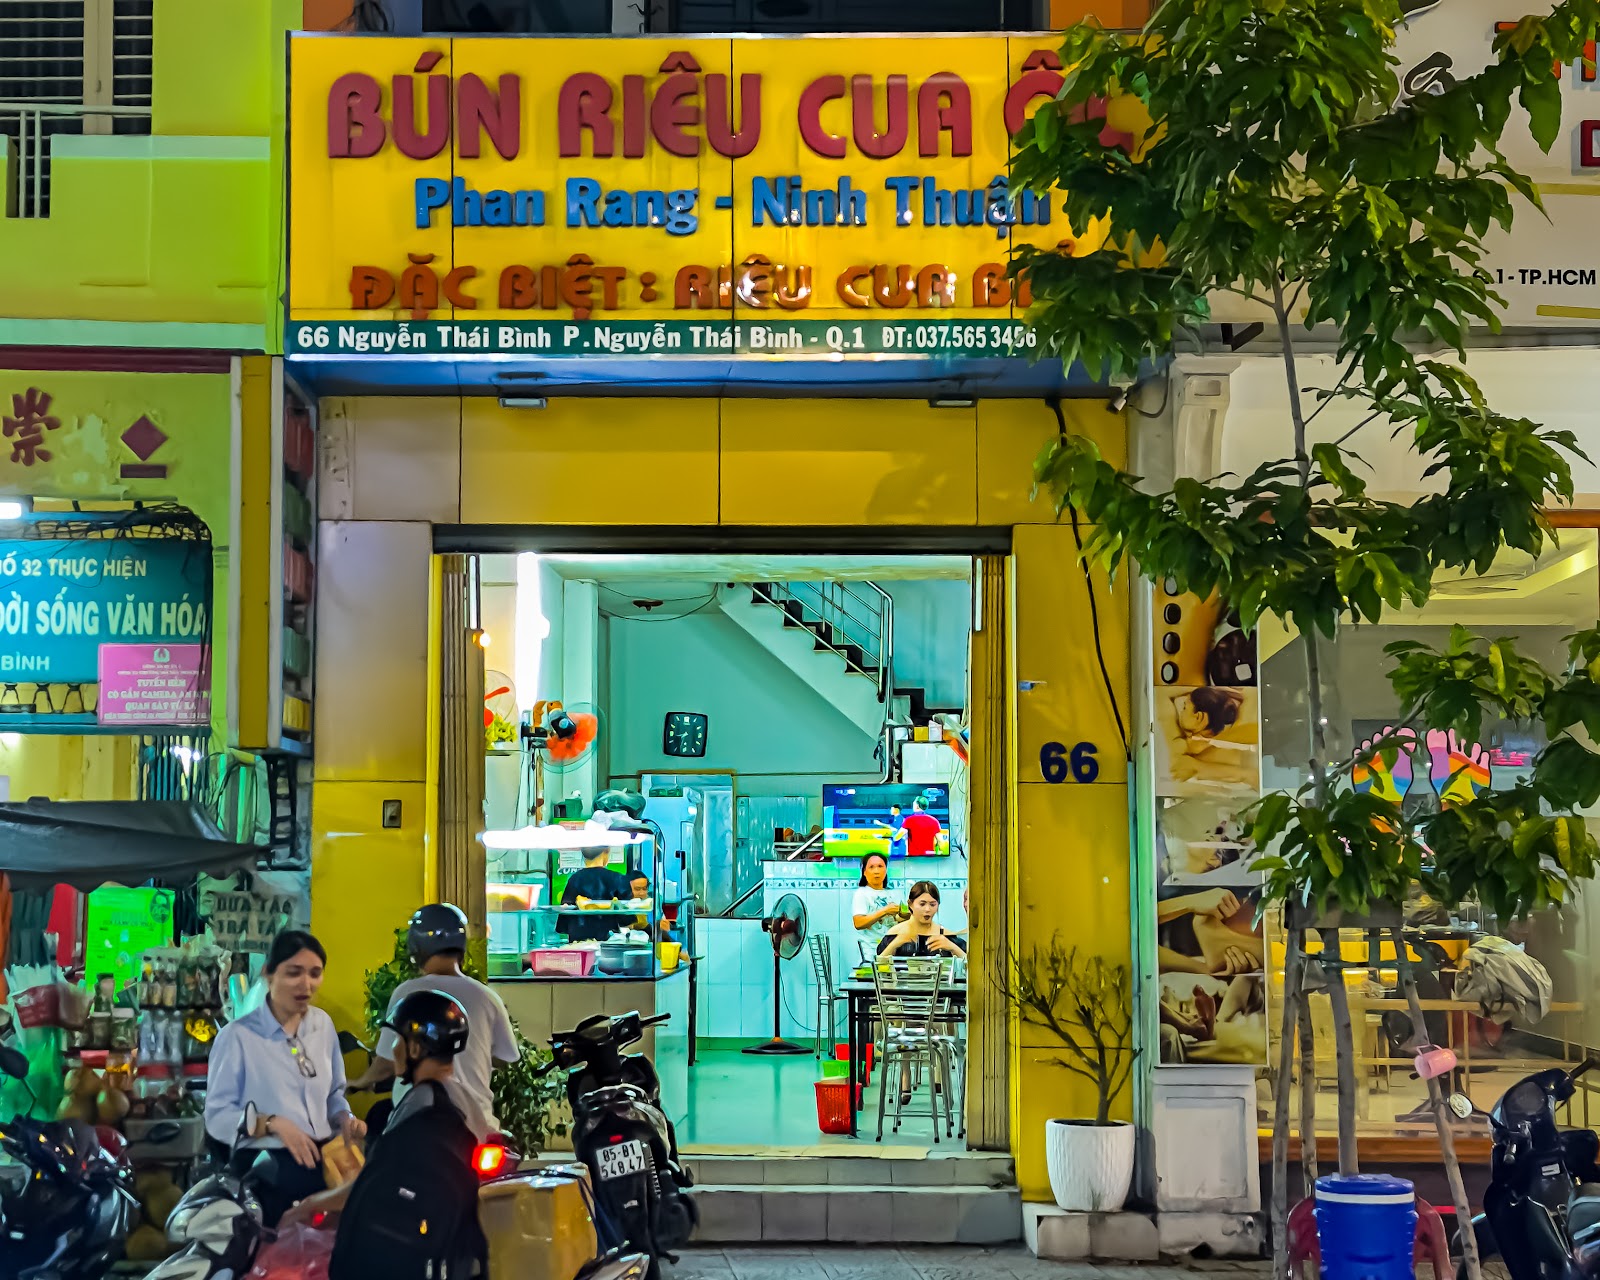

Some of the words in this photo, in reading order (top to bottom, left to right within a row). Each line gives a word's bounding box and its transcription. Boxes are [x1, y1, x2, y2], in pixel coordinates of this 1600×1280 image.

[328, 51, 520, 160] BÚN
[558, 51, 762, 160] RIÊU
[798, 72, 972, 160] CUA
[415, 176, 545, 228] Phan
[567, 176, 699, 236] Rang
[752, 176, 868, 227] Ninh
[885, 175, 1050, 239] Thuận
[349, 254, 479, 320] ĐẶC
[674, 254, 812, 309] RIÊU
[836, 263, 956, 308] CUA
[1518, 269, 1596, 286] TP.HCM
[298, 326, 329, 348] 66
[339, 323, 427, 352] Nguyễn
[437, 326, 489, 348] Thái
[499, 326, 551, 348] Bình
[689, 326, 741, 348] Thái
[751, 326, 803, 348] Bình
[826, 326, 865, 352] Q.1
[22, 558, 42, 577] 32
[48, 557, 98, 579] THỰC
[103, 556, 146, 580] HIỆN
[36, 587, 99, 636] SỐNG
[107, 594, 154, 636] VĂN
[1, 652, 50, 671] BÌNH
[1040, 742, 1099, 784] 66
